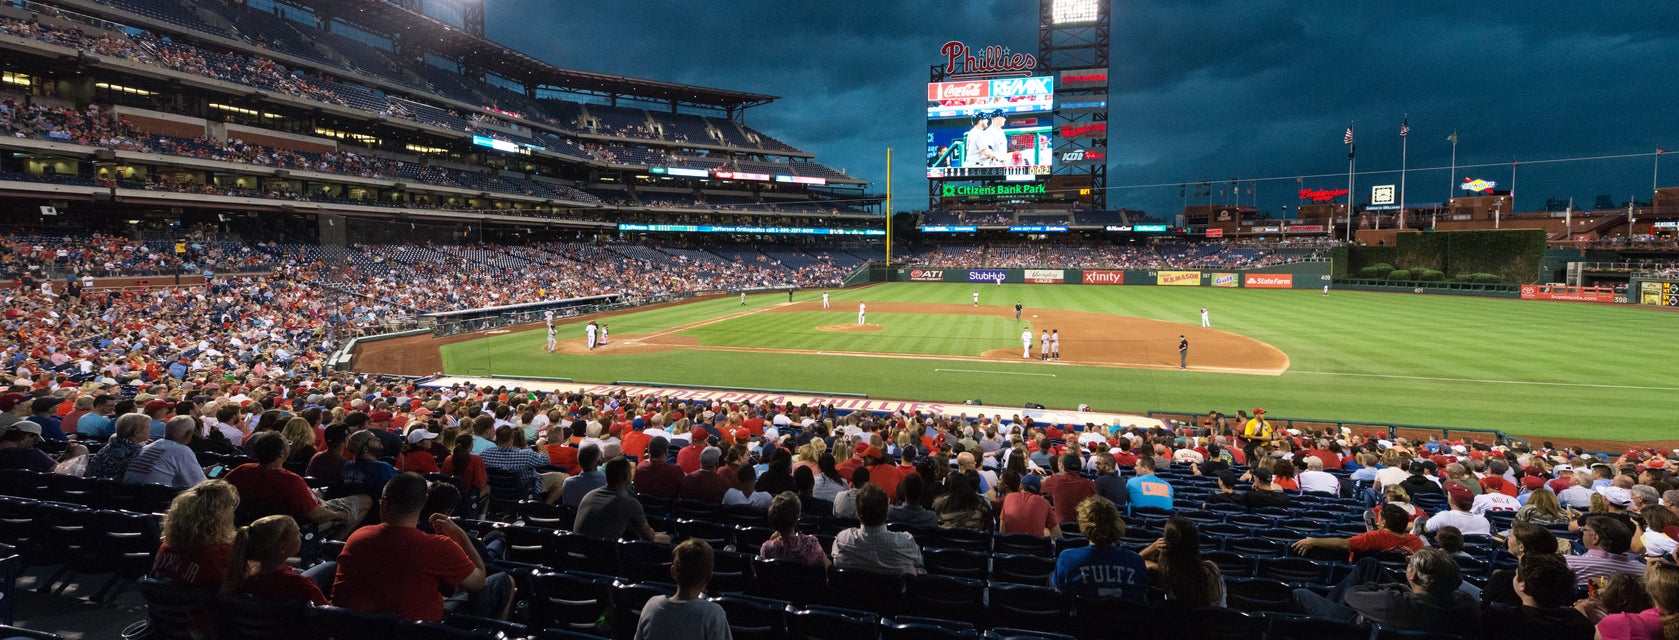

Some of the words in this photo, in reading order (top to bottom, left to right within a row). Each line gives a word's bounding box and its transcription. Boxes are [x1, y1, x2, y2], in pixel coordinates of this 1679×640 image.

[941, 40, 1036, 74] Phillies
[1072, 73, 1107, 82] TOYOTA
[993, 78, 1051, 96] RE/MAX
[957, 186, 996, 195] Citizens
[997, 184, 1022, 194] Bank
[1023, 183, 1046, 193] Park
[920, 270, 944, 278] ATI
[969, 271, 1006, 280] StubHub
[1085, 271, 1121, 283] xfinity
[1215, 275, 1234, 284] Gulf
[1614, 296, 1628, 304] 398
[584, 384, 786, 404] PHILADELPHIA
[806, 396, 945, 415] PHILLIES
[1079, 564, 1135, 585] FULTZ
